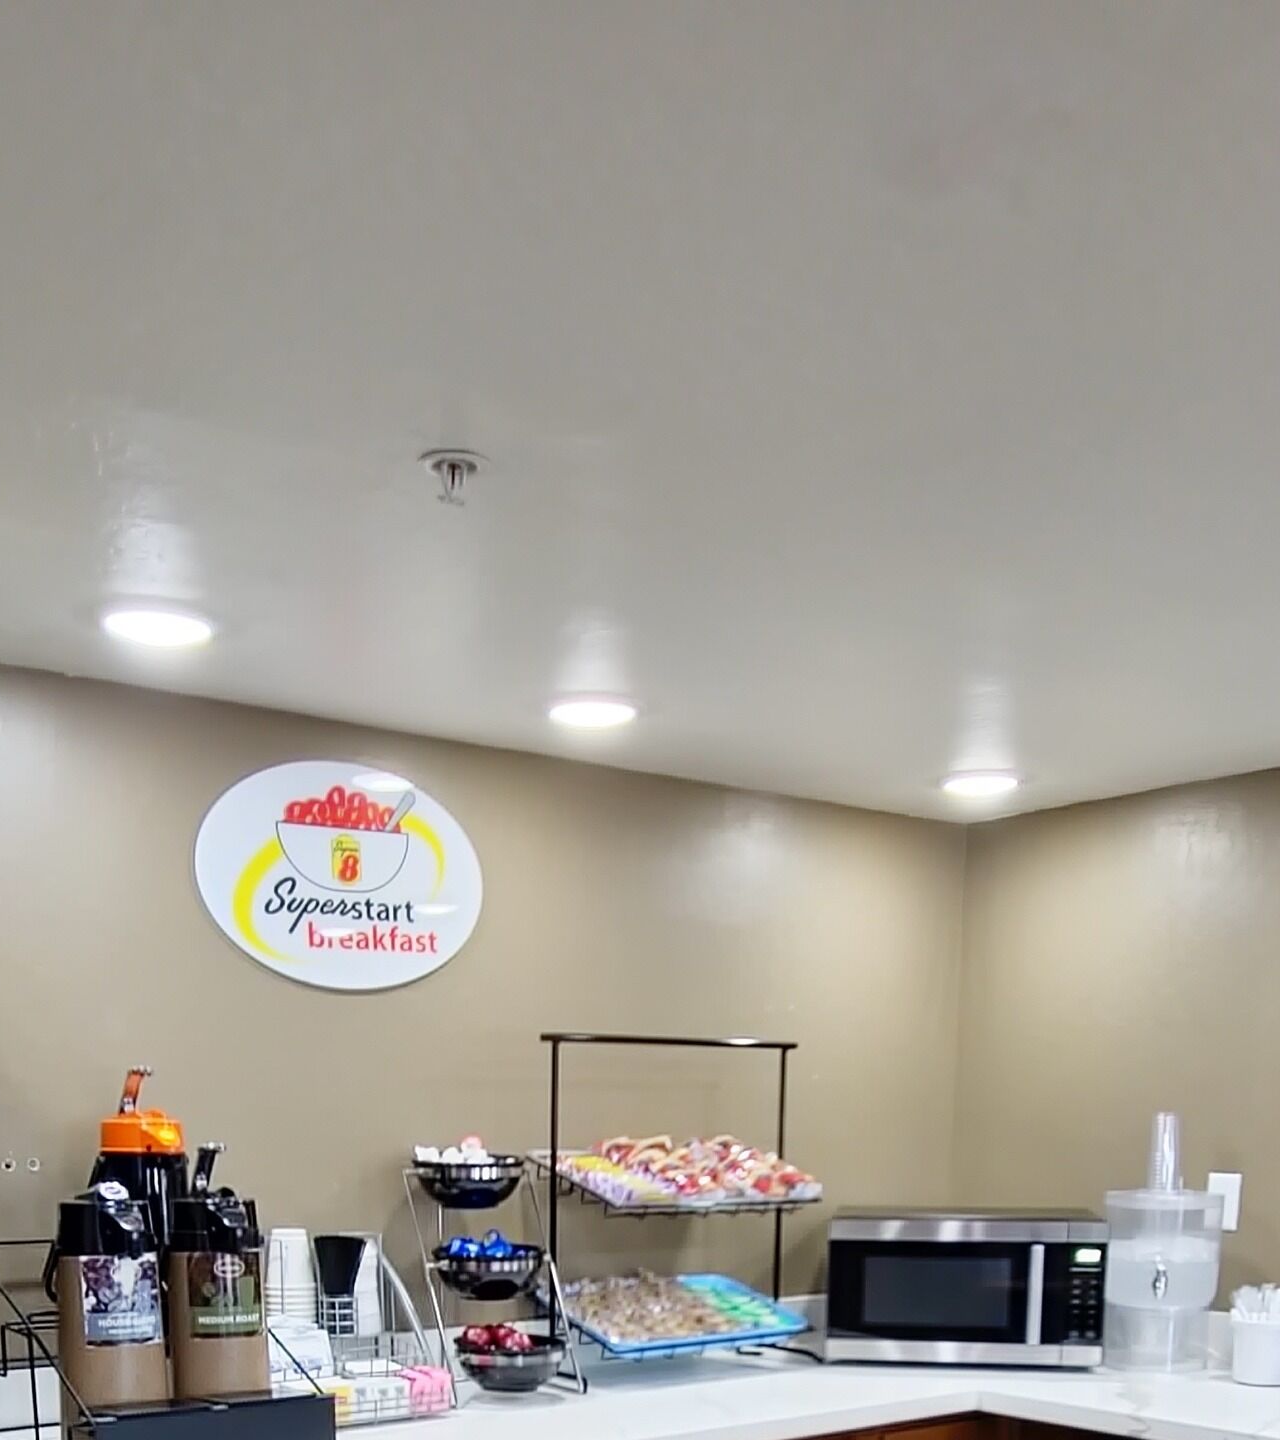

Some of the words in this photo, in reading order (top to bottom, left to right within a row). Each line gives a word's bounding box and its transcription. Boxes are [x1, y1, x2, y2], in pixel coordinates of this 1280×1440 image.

[338, 854, 359, 881] 8
[264, 877, 415, 934] Superstart
[308, 922, 438, 953] breakfast
